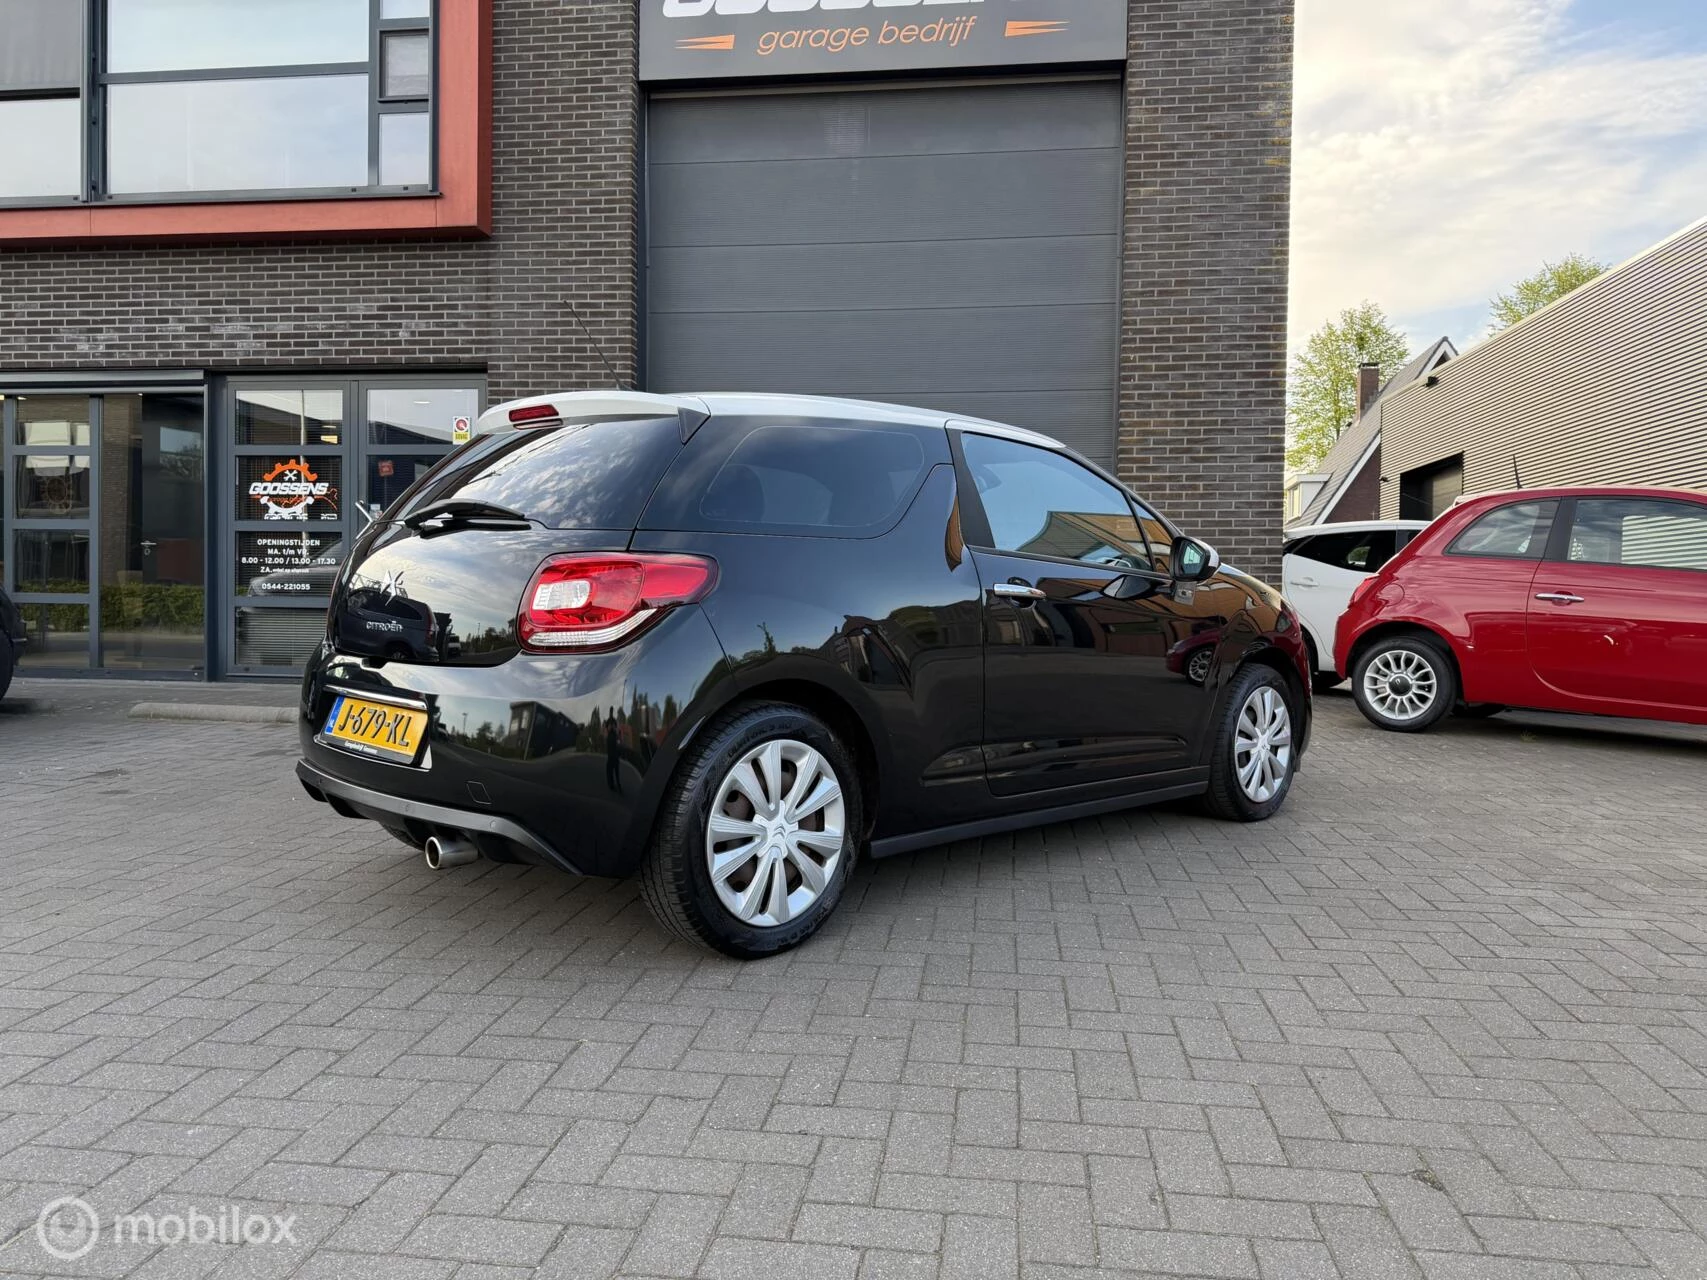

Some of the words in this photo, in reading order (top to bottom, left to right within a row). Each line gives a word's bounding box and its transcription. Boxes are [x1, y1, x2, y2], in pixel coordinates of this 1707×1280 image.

[756, 25, 869, 55] garage
[877, 15, 978, 47] bedrijf
[249, 482, 329, 495] GOOSSENS
[257, 538, 321, 546] OPENINGSTIJDEN
[291, 557, 311, 565] 13.00
[338, 704, 412, 747] J-679-KL
